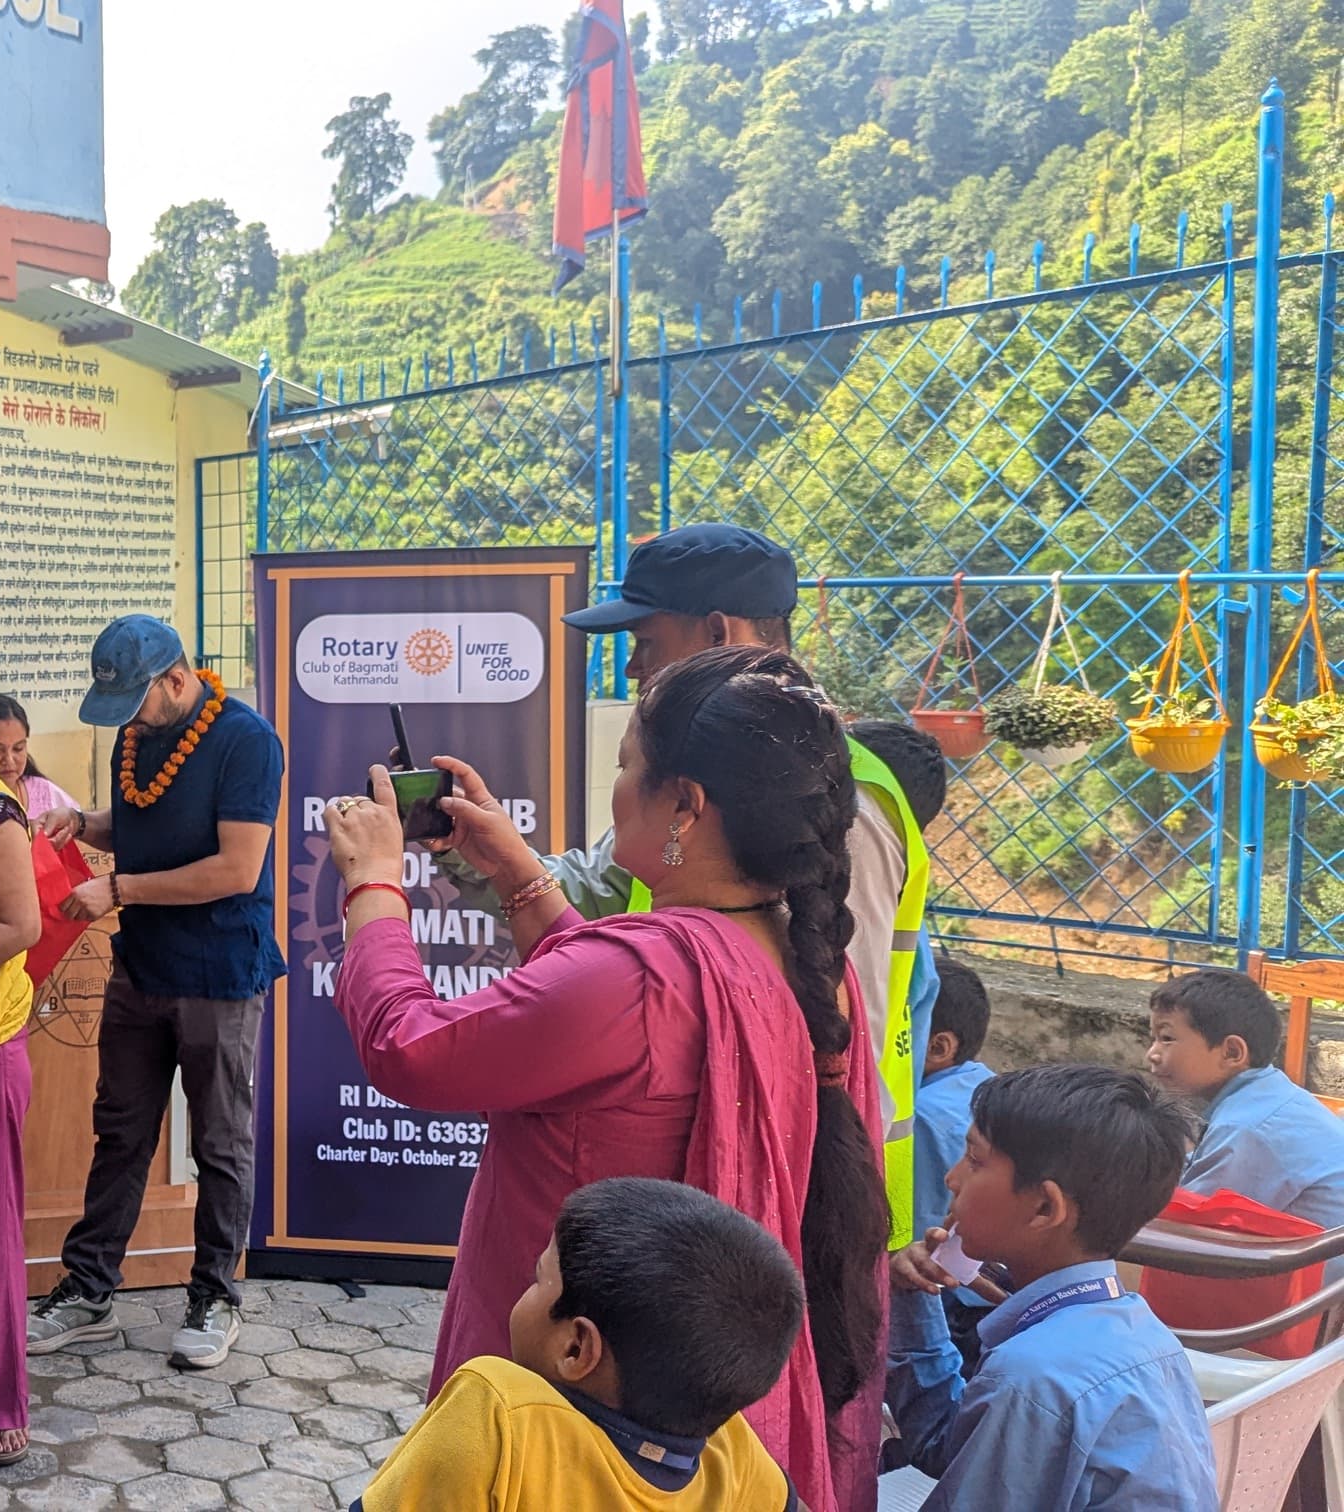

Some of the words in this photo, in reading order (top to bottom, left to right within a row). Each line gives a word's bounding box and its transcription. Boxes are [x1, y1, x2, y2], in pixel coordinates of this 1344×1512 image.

[2, 396, 20, 420] मेरो
[56, 402, 66, 426] के
[322, 637, 398, 660] Rotary
[465, 643, 509, 656] UNITE
[302, 661, 330, 674] Club
[333, 660, 346, 673] of
[348, 661, 398, 675] Bagmati
[481, 657, 512, 669] FOR
[333, 674, 398, 685] Kathmandu
[485, 669, 530, 681] GOOD
[80, 942, 90, 955] S
[49, 996, 58, 1010] B
[340, 1085, 360, 1107] RI
[343, 1117, 388, 1141] Club
[394, 1119, 422, 1142] ID:
[317, 1144, 367, 1162] Charter
[371, 1147, 399, 1166] Day:
[402, 1148, 456, 1166] October
[1057, 1288, 1078, 1301] Basic
[1077, 1281, 1103, 1294] School
